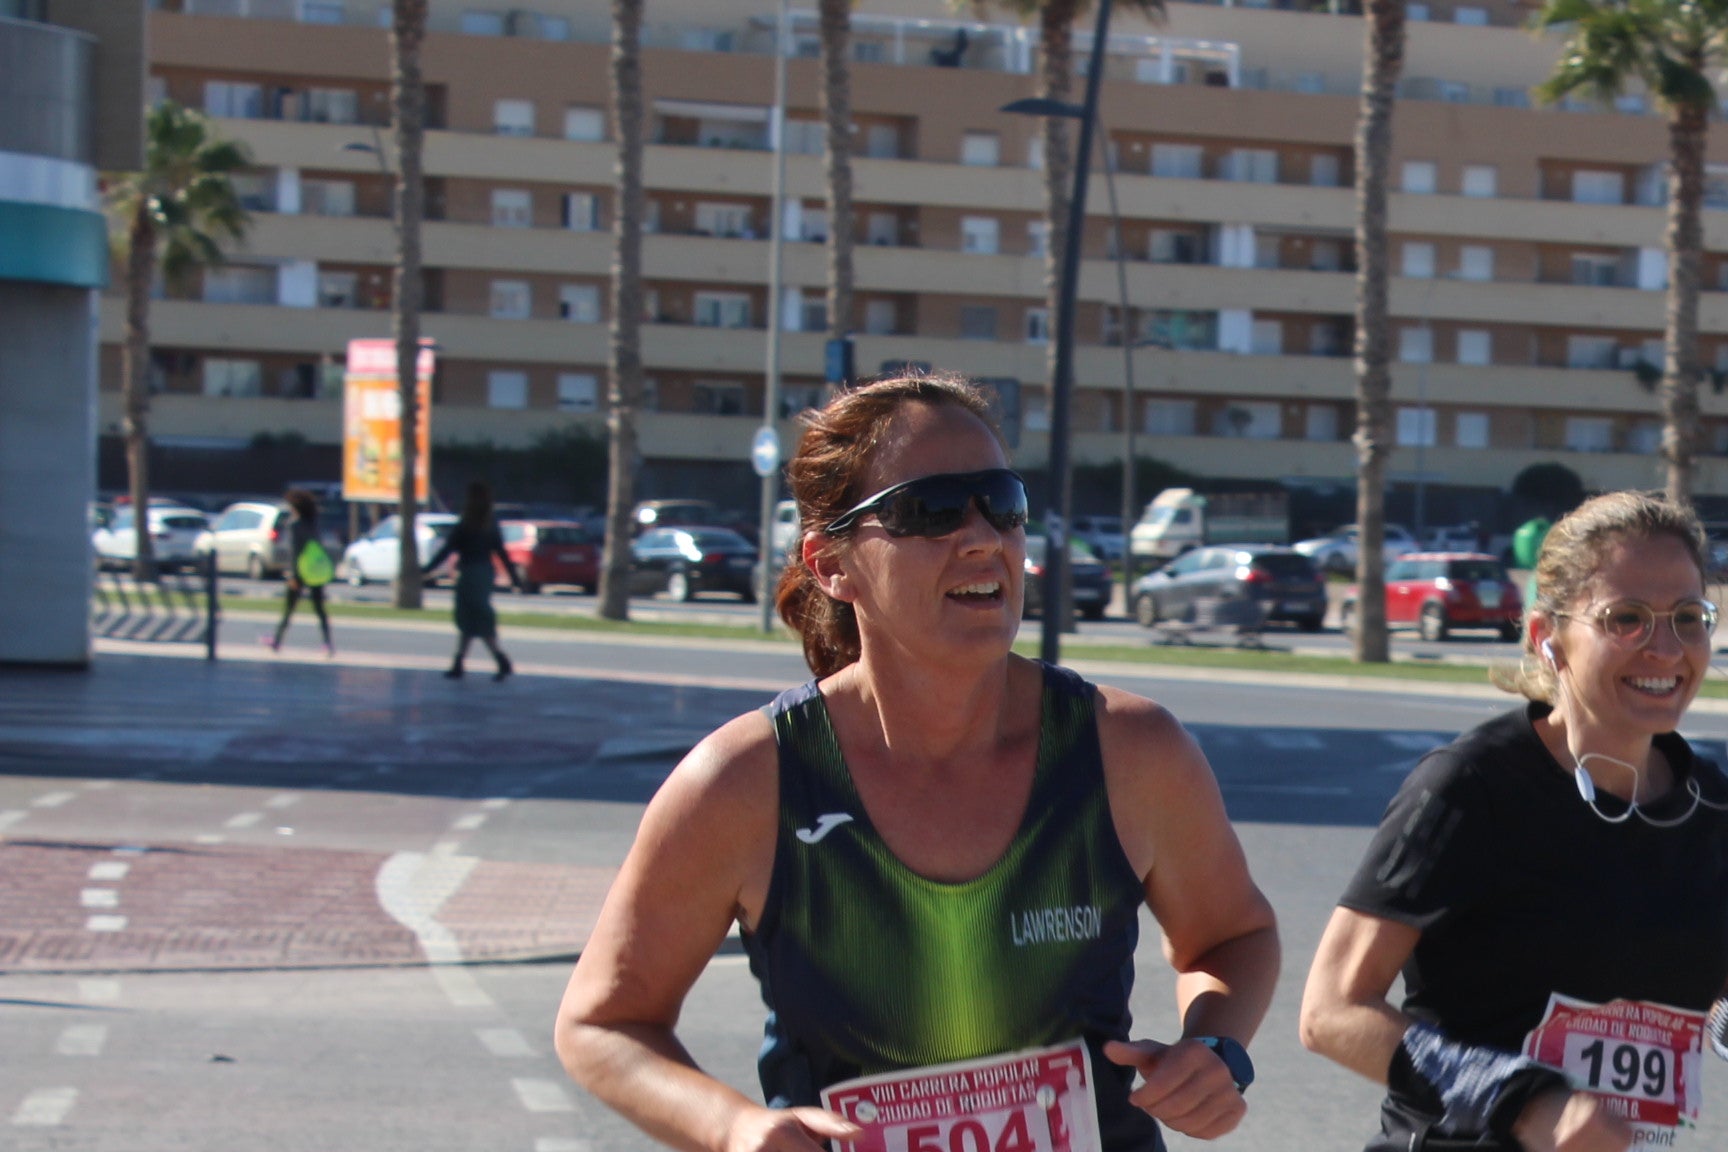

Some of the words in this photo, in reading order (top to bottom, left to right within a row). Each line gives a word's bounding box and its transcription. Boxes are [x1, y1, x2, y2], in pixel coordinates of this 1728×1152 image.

[1010, 904, 1102, 947] LAWRENSON
[870, 1083, 896, 1104] VIII
[901, 1072, 970, 1098] CARRERA
[974, 1057, 1041, 1087] POPULAR
[1580, 1038, 1666, 1097] 199
[875, 1099, 932, 1123] CIUDAD
[936, 1094, 957, 1116] DE
